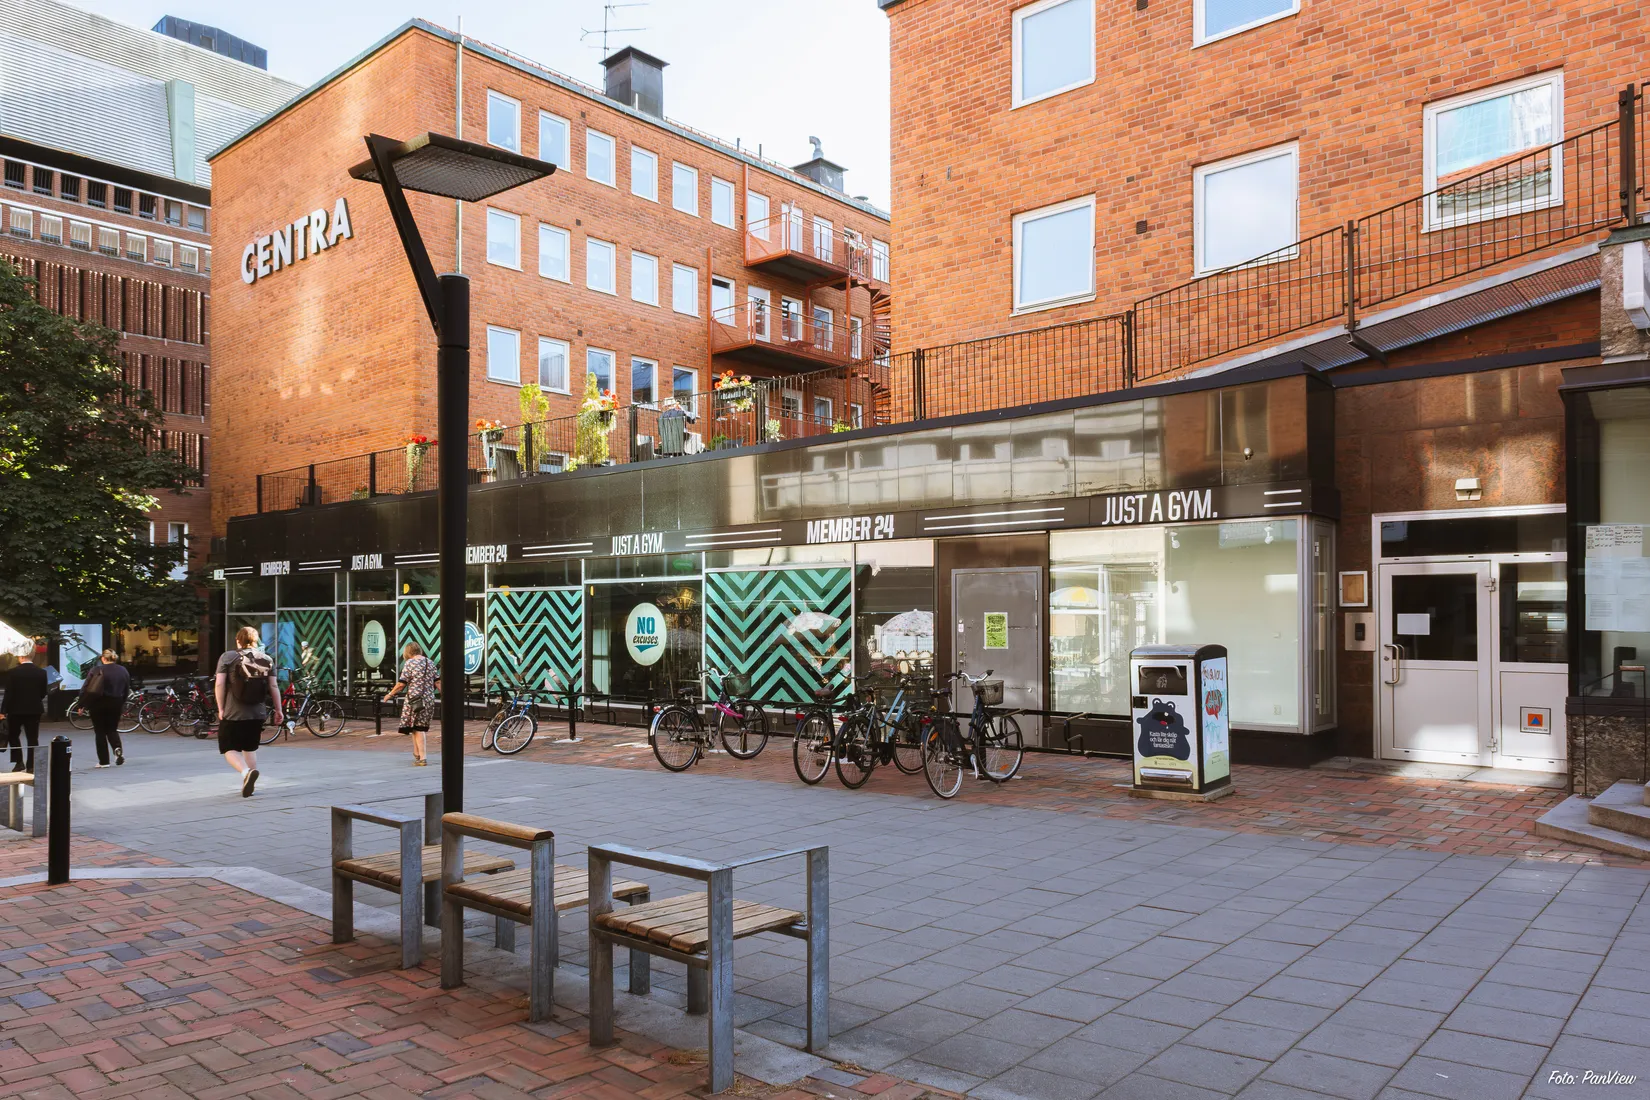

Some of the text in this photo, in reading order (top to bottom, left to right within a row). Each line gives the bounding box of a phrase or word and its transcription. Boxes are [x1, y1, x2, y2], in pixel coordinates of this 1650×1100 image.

[241, 197, 354, 284] CENTRA
[1466, 490, 1473, 500] 7
[1102, 489, 1218, 525] JUST A GYM.
[806, 514, 895, 544] MEMBER 24
[496, 544, 507, 562] 24
[610, 532, 665, 556] JUST A GYM.
[260, 560, 291, 576] MEMBER 24
[350, 555, 365, 570] JUST
[364, 555, 369, 569] A
[636, 616, 656, 634] NO
[633, 635, 659, 645] excuses
